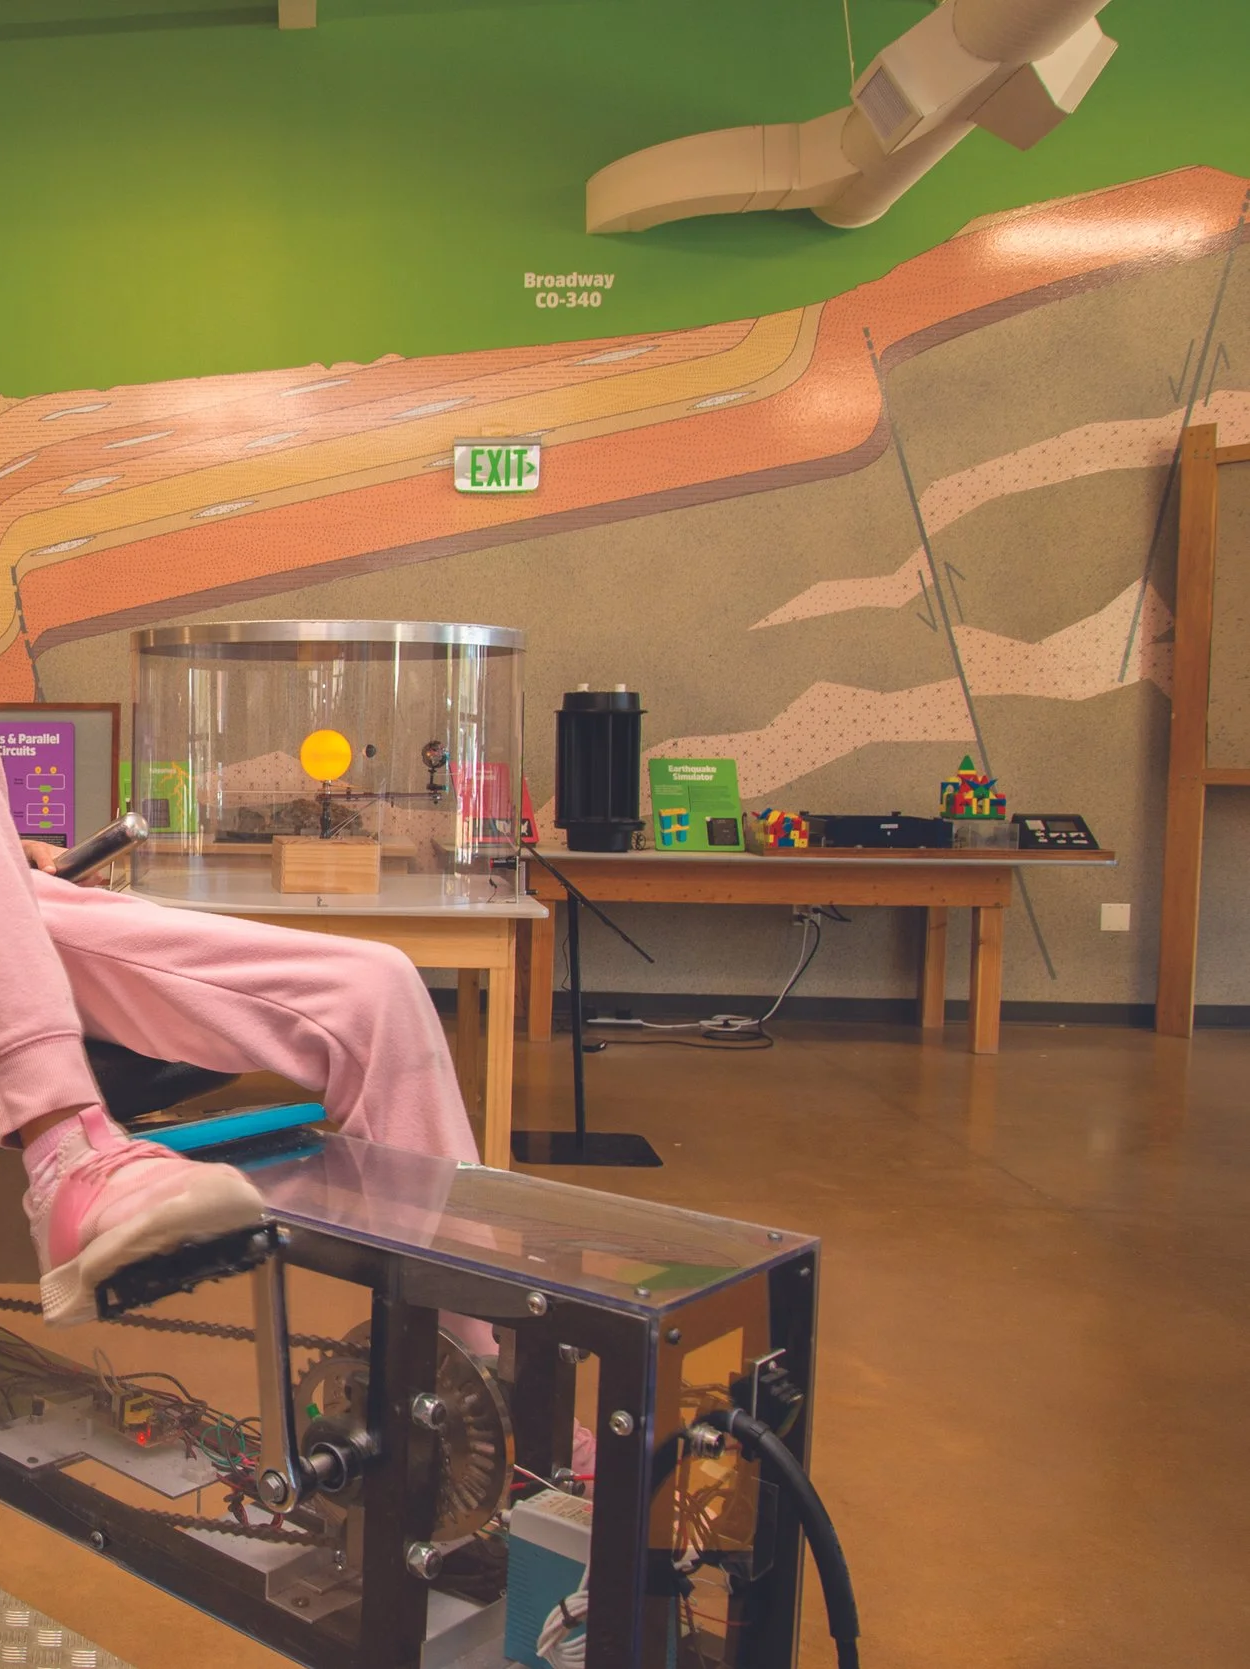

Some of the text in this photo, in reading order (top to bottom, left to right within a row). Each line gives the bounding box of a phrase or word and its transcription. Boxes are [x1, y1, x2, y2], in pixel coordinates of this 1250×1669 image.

[523, 271, 616, 290] Broadway
[535, 291, 603, 309] CO-340
[470, 448, 528, 487] EXIT
[7, 733, 16, 744] &
[18, 733, 60, 744] Parallel
[668, 765, 717, 774] Earthquake
[672, 773, 714, 781] Simulator
